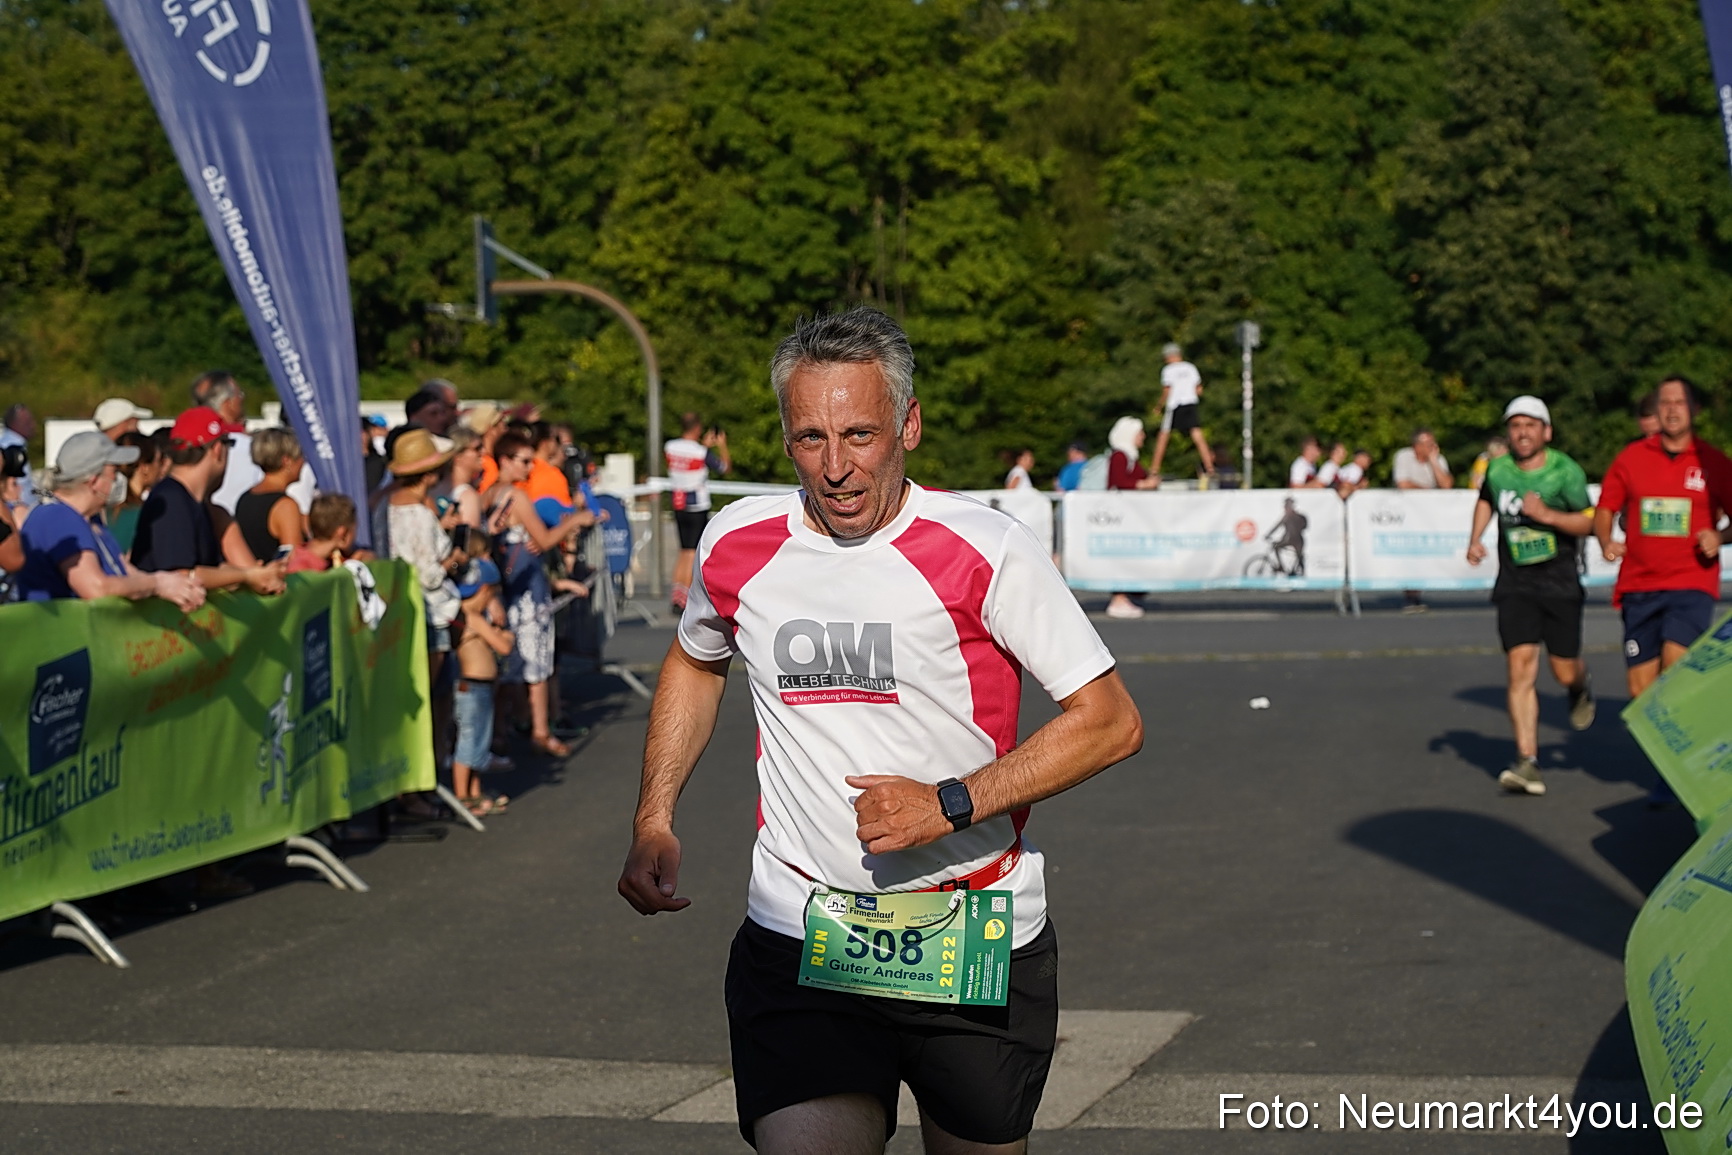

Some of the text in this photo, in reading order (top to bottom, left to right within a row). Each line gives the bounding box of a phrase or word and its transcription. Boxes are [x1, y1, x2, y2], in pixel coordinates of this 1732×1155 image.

[774, 619, 894, 679] OM
[781, 675, 896, 690] KLEBE TECHNIK
[784, 695, 798, 703] Ihre
[798, 692, 840, 703] Verbindung
[841, 692, 851, 700] für
[2, 723, 127, 845] firmenlauf
[849, 907, 895, 919] Firmenlauf
[971, 904, 979, 919] AOK
[810, 929, 829, 967] RUN
[844, 924, 924, 966] 508
[829, 959, 935, 982] Guter Andreas
[939, 936, 957, 987] 2022
[967, 964, 975, 983] Laufen
